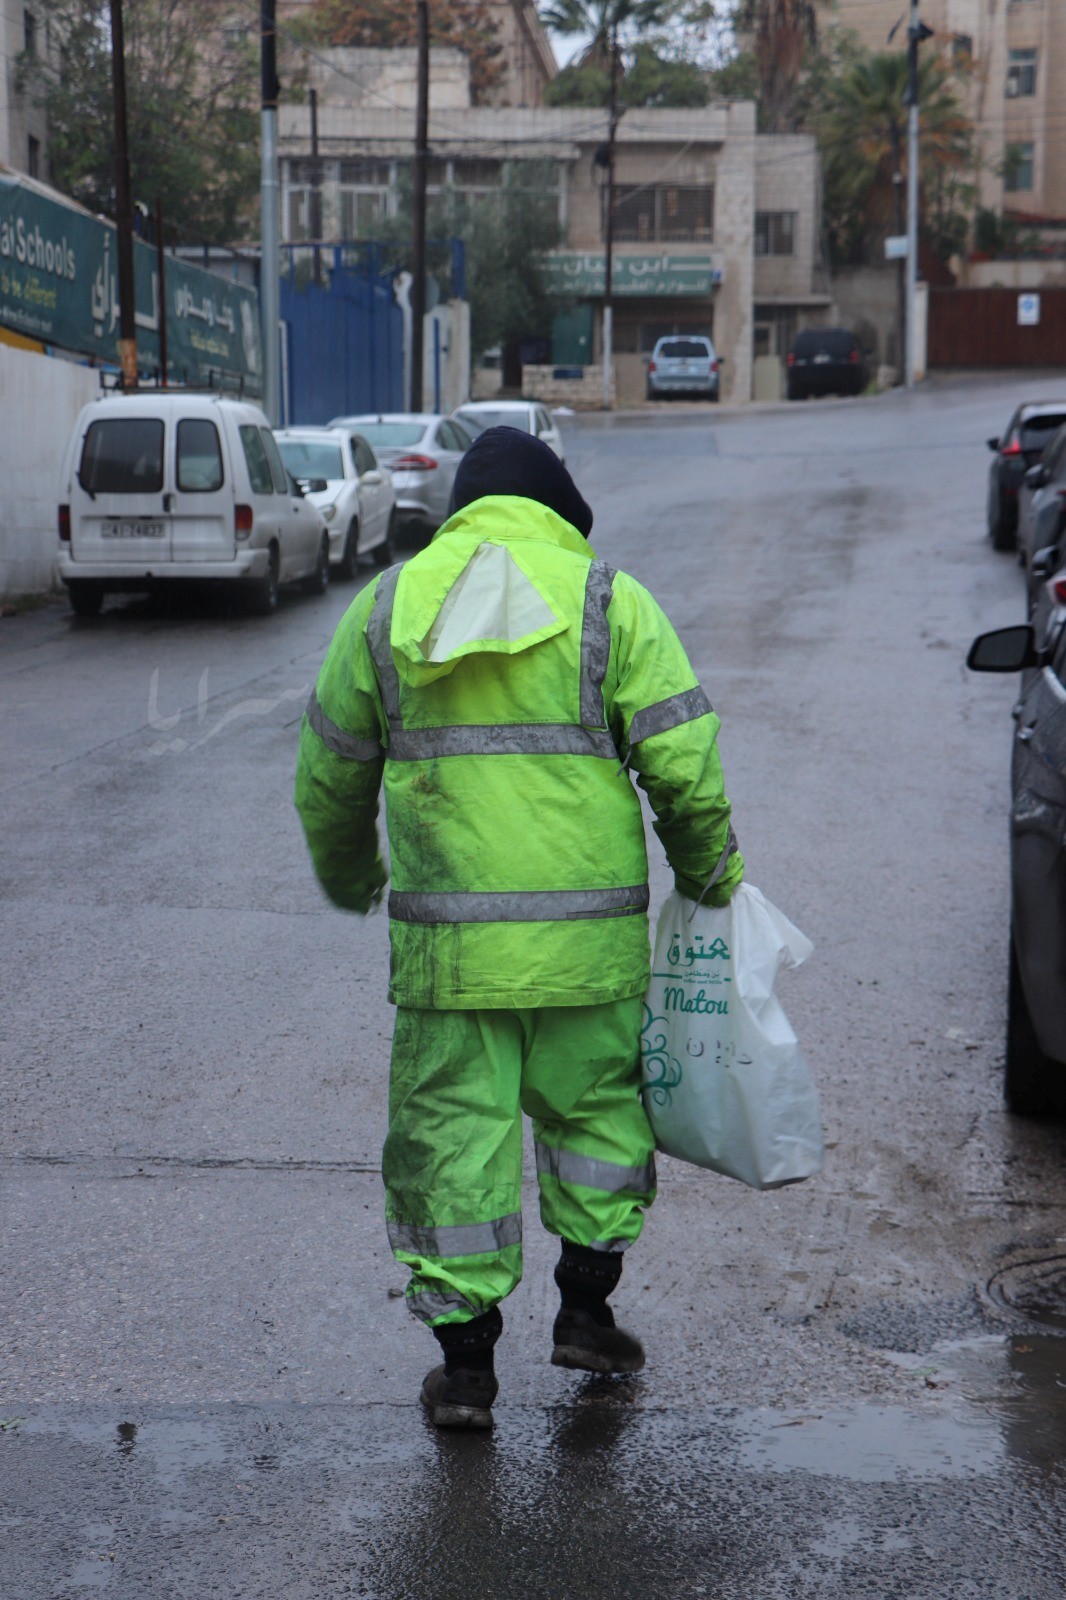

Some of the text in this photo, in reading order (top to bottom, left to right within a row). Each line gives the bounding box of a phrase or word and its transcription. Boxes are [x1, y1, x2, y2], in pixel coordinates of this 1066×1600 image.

[0, 214, 76, 281] ai Schools
[666, 933, 731, 967] عتوق
[664, 987, 729, 1015] Matou
